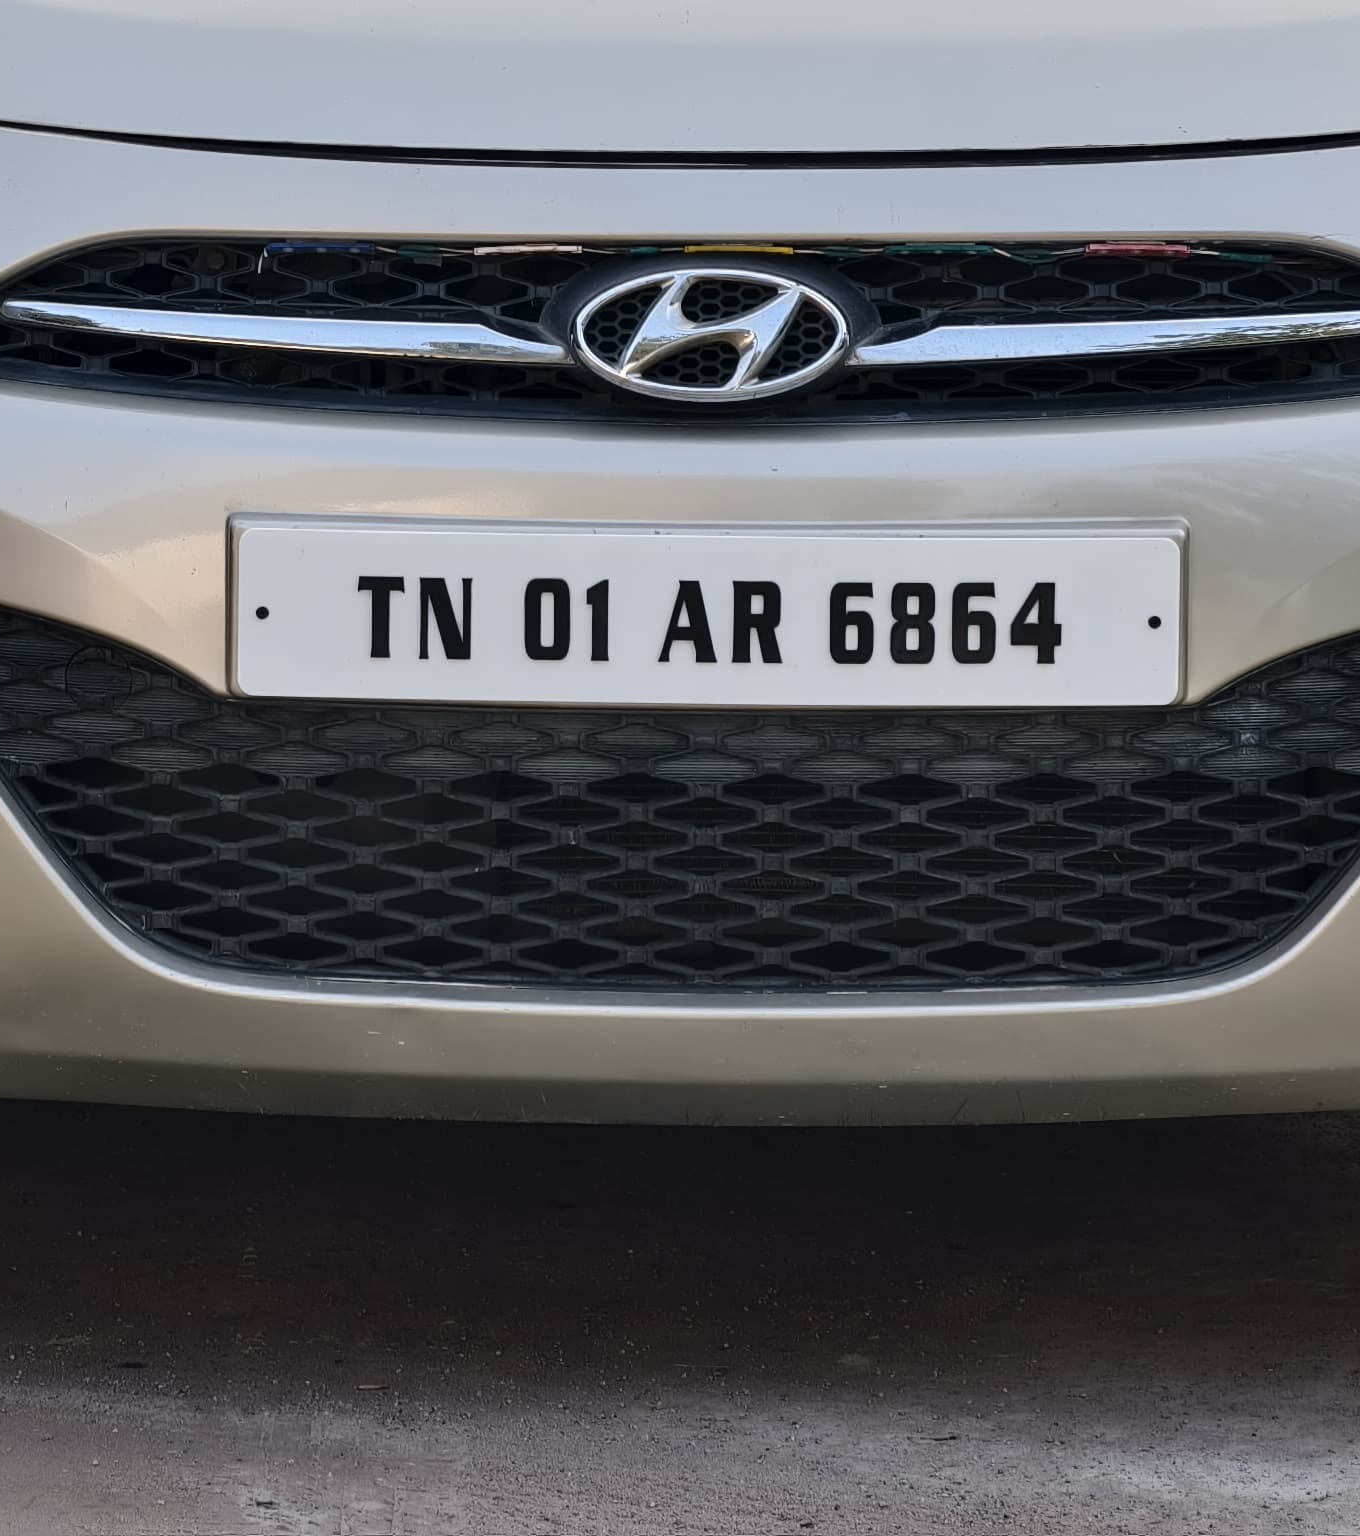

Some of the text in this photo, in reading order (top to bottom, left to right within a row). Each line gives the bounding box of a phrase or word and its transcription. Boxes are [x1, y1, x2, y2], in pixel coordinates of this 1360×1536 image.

[357, 575, 1063, 666] TN 01 AR 6864
